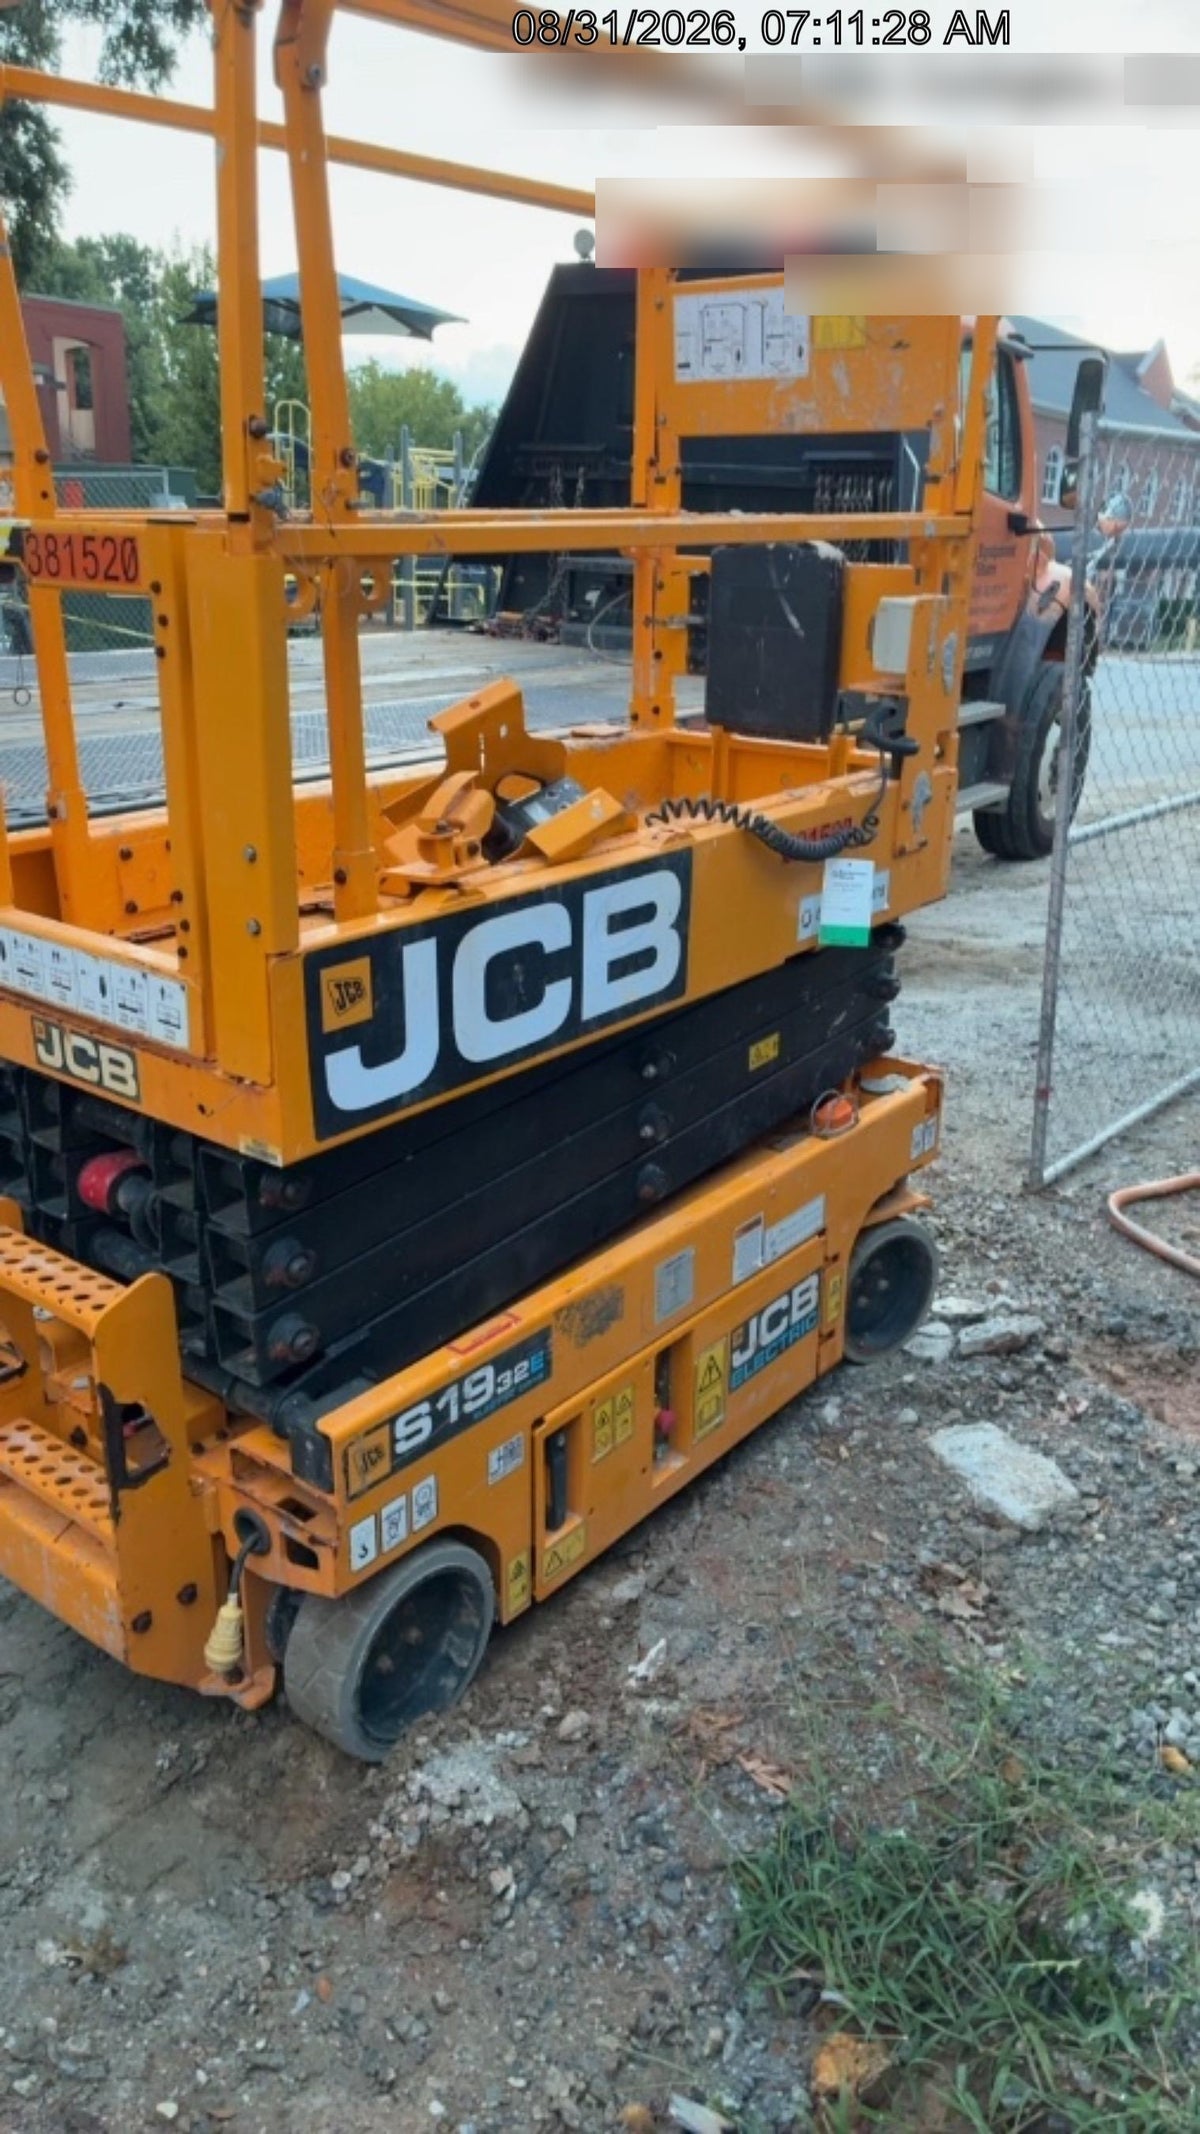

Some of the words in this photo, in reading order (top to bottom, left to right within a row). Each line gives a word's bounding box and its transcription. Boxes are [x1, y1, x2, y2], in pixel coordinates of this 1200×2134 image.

[25, 532, 139, 583] 381520
[324, 870, 682, 1111] JCB
[334, 977, 366, 1011] JCB
[36, 1026, 138, 1097] JCB
[731, 1308, 818, 1389] ELECTRIC
[733, 1273, 819, 1369] JCB
